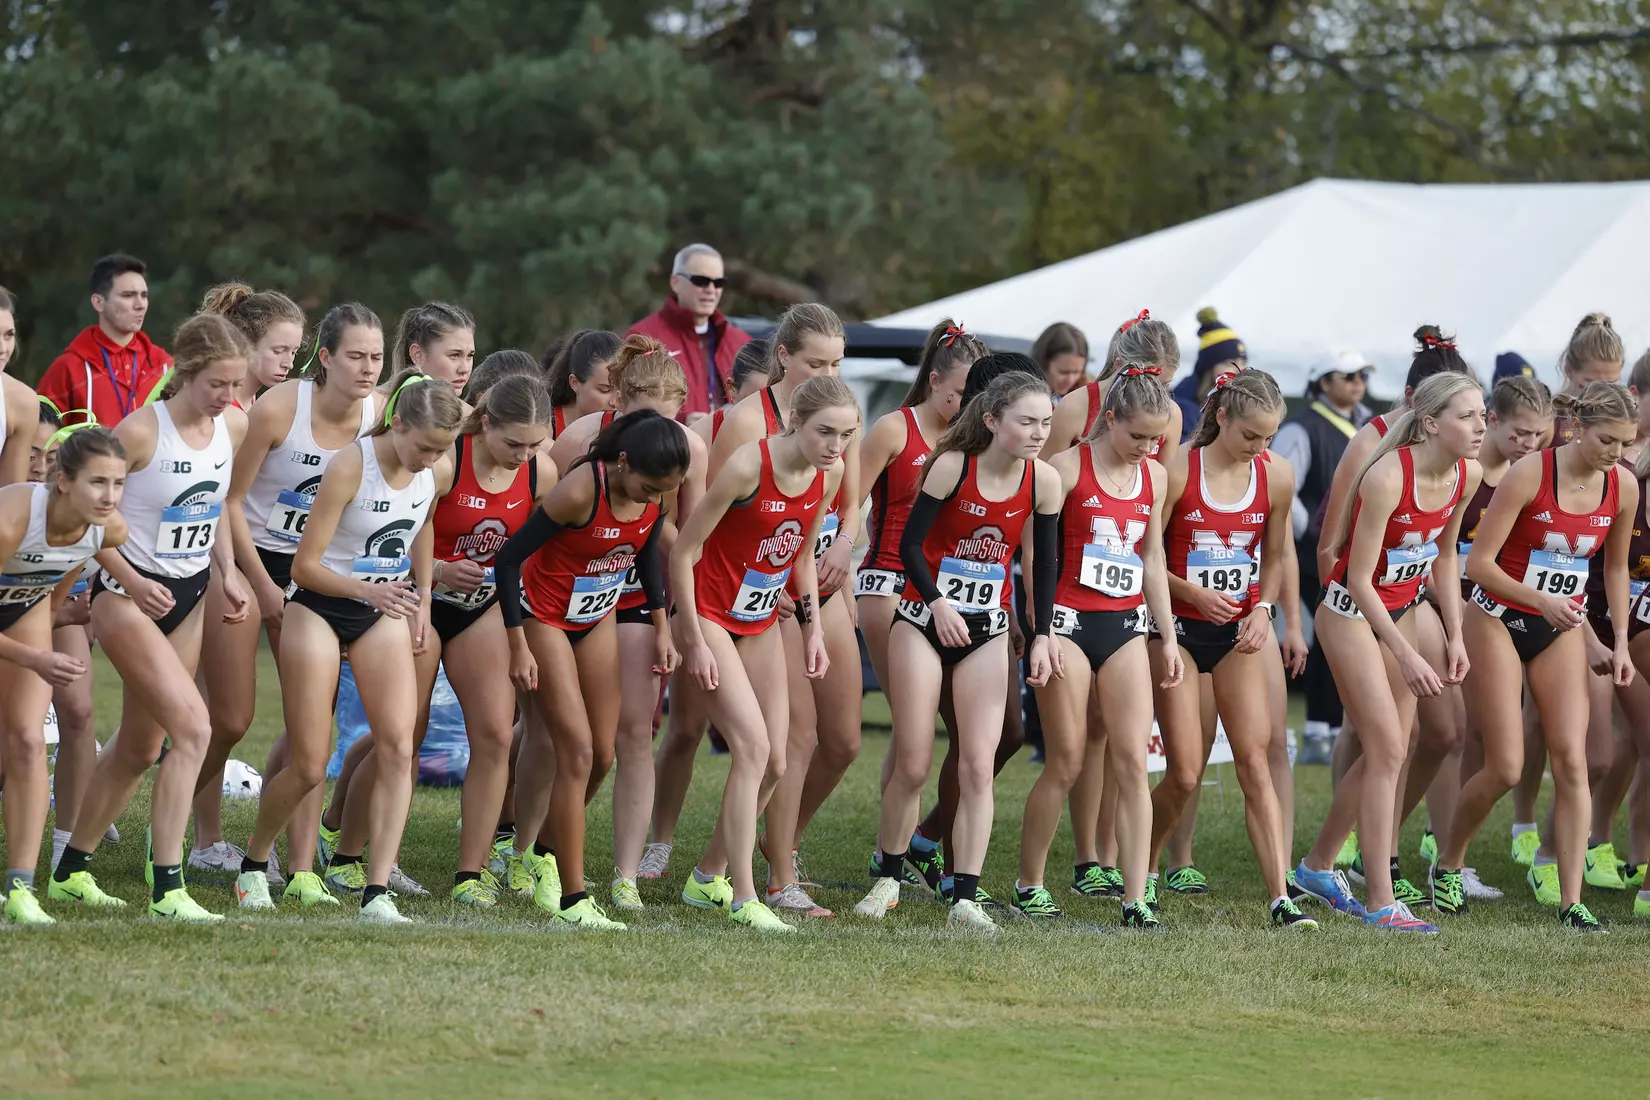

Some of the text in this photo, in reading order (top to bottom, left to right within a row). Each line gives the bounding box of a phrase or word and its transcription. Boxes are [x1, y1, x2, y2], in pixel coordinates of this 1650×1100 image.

[171, 523, 212, 549] 173
[859, 574, 887, 591] 197
[1093, 562, 1134, 591] 195
[1198, 568, 1242, 592] 193
[1393, 560, 1428, 583] 191
[1536, 570, 1579, 595] 199
[577, 588, 618, 615] 222
[744, 587, 782, 612] 218
[946, 578, 994, 605] 219
